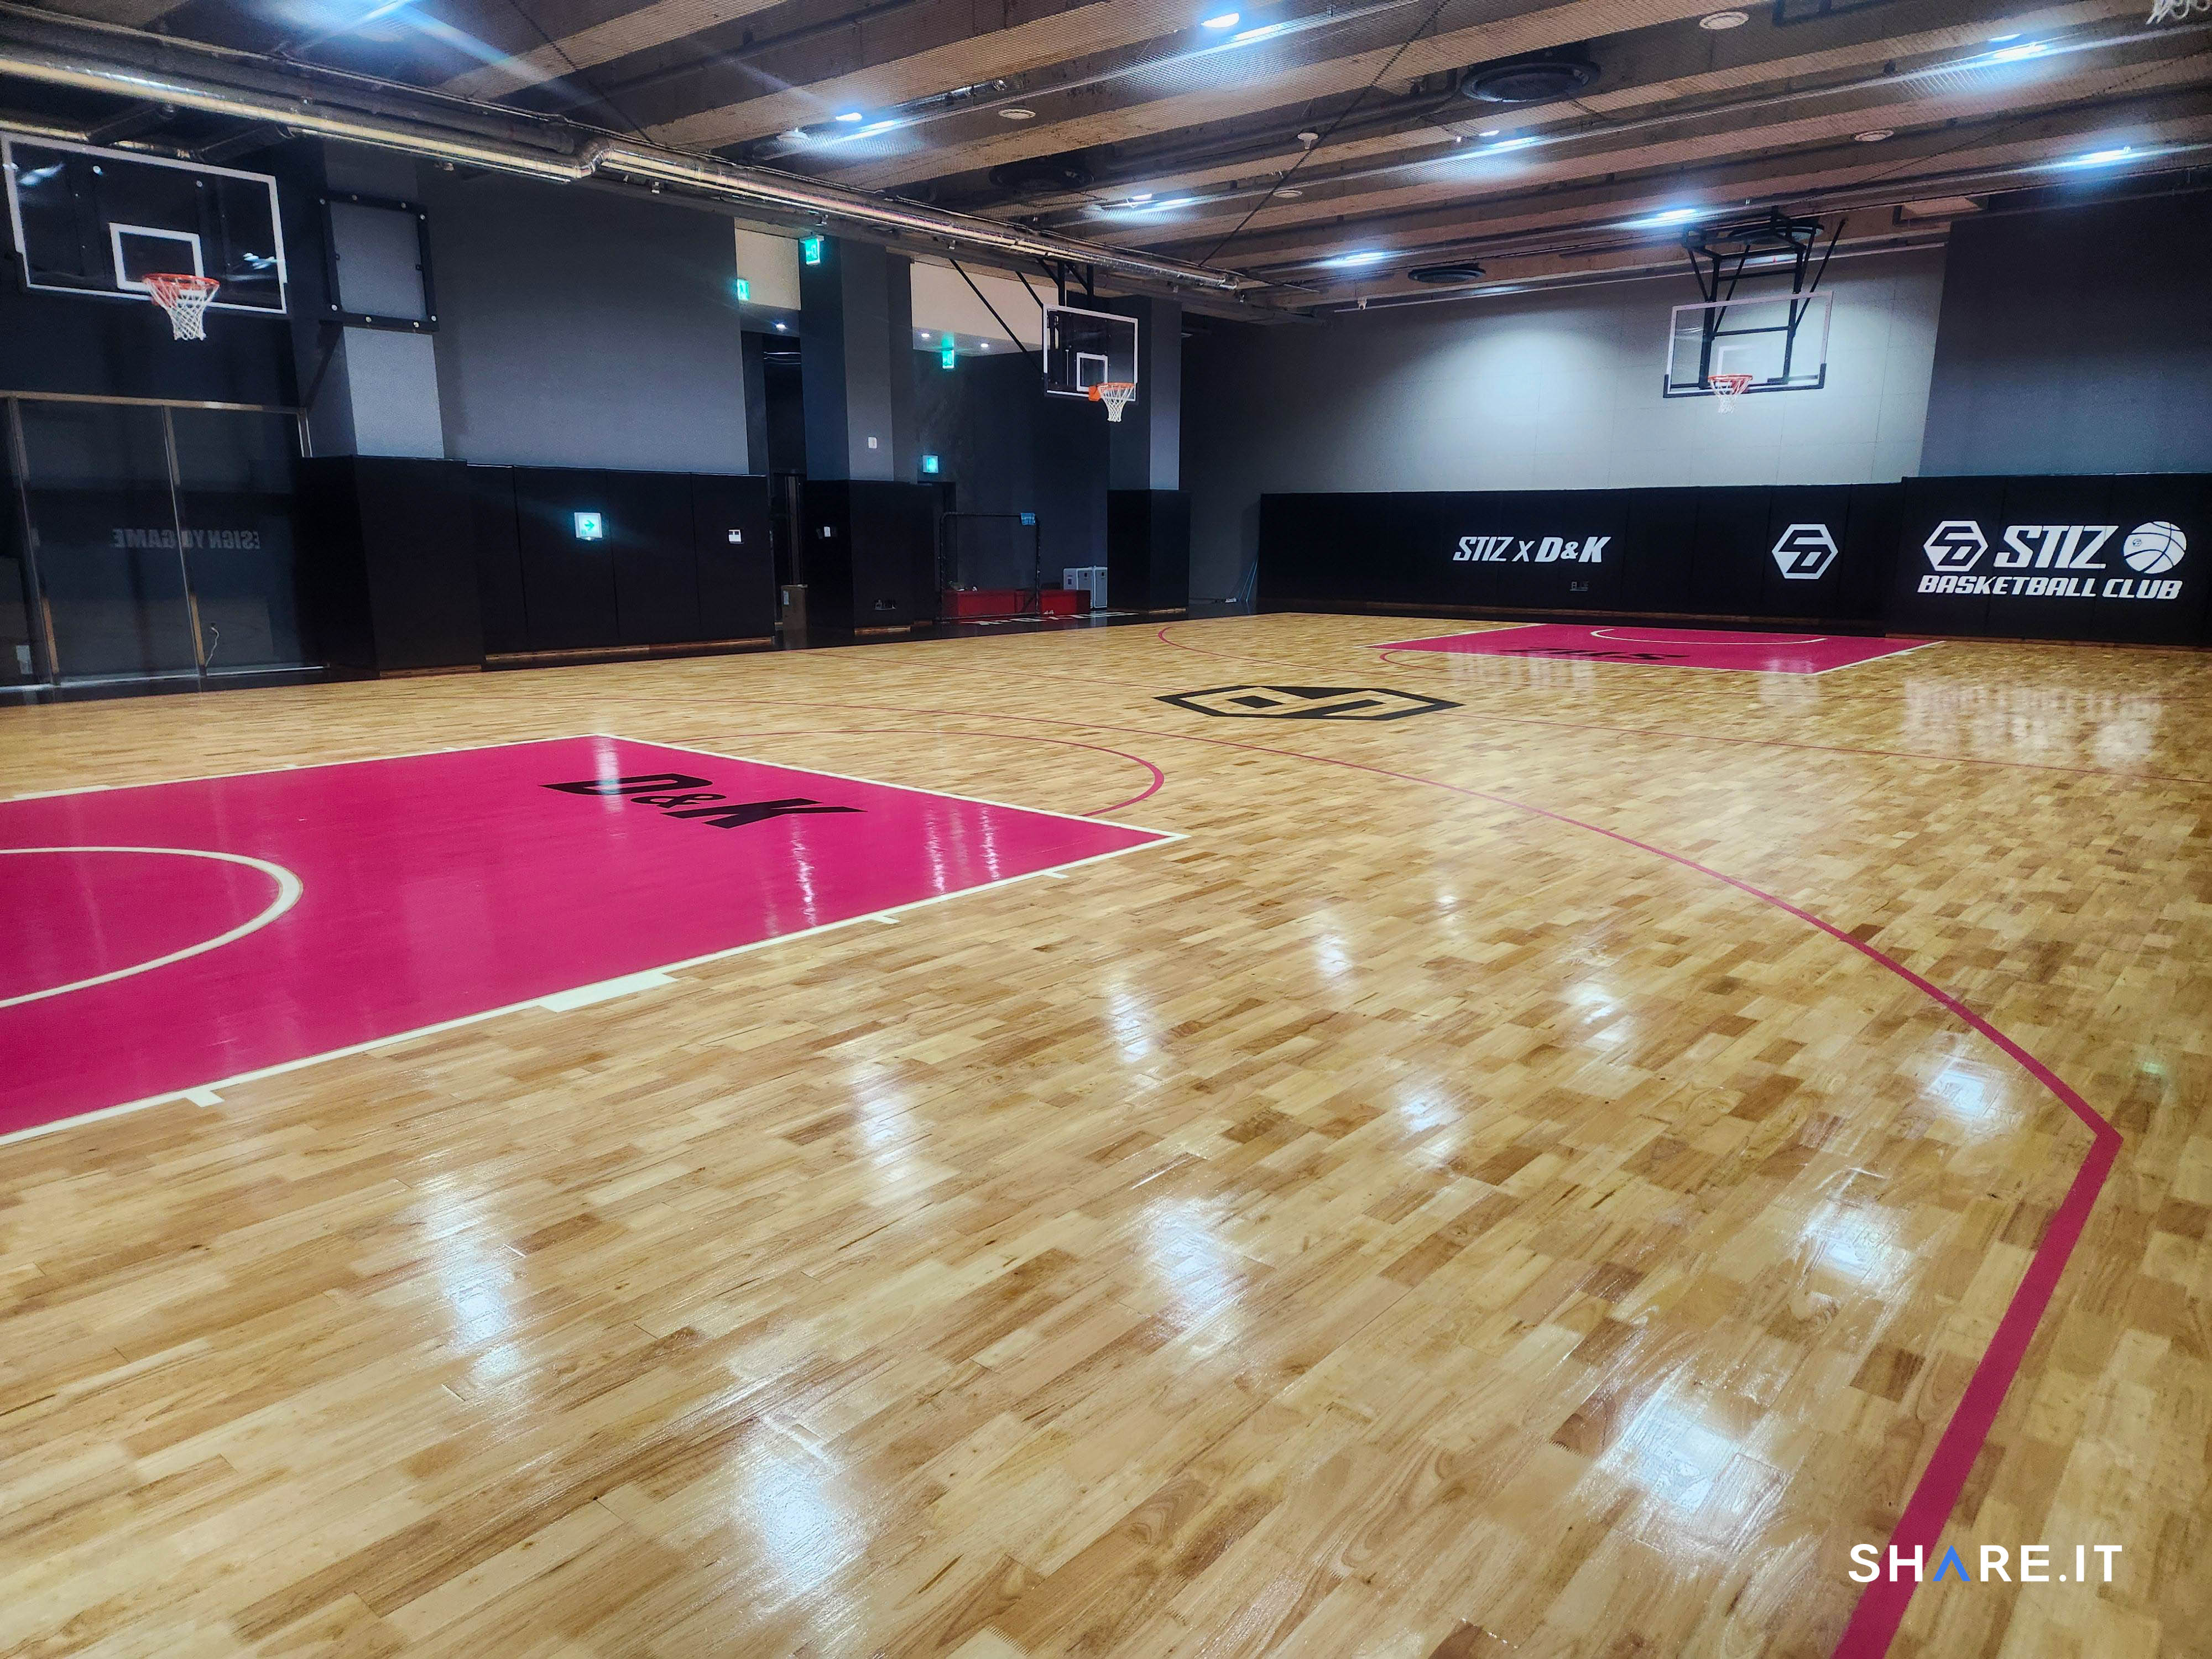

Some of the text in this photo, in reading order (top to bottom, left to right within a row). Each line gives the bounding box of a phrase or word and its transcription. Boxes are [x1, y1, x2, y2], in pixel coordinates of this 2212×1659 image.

[1452, 536, 1514, 562] STIZ
[1534, 536, 1612, 563] D&K
[1992, 525, 2119, 569] STIZ
[1917, 574, 2183, 599] BASKETBALL CLUB
[539, 773, 868, 830] D&K
